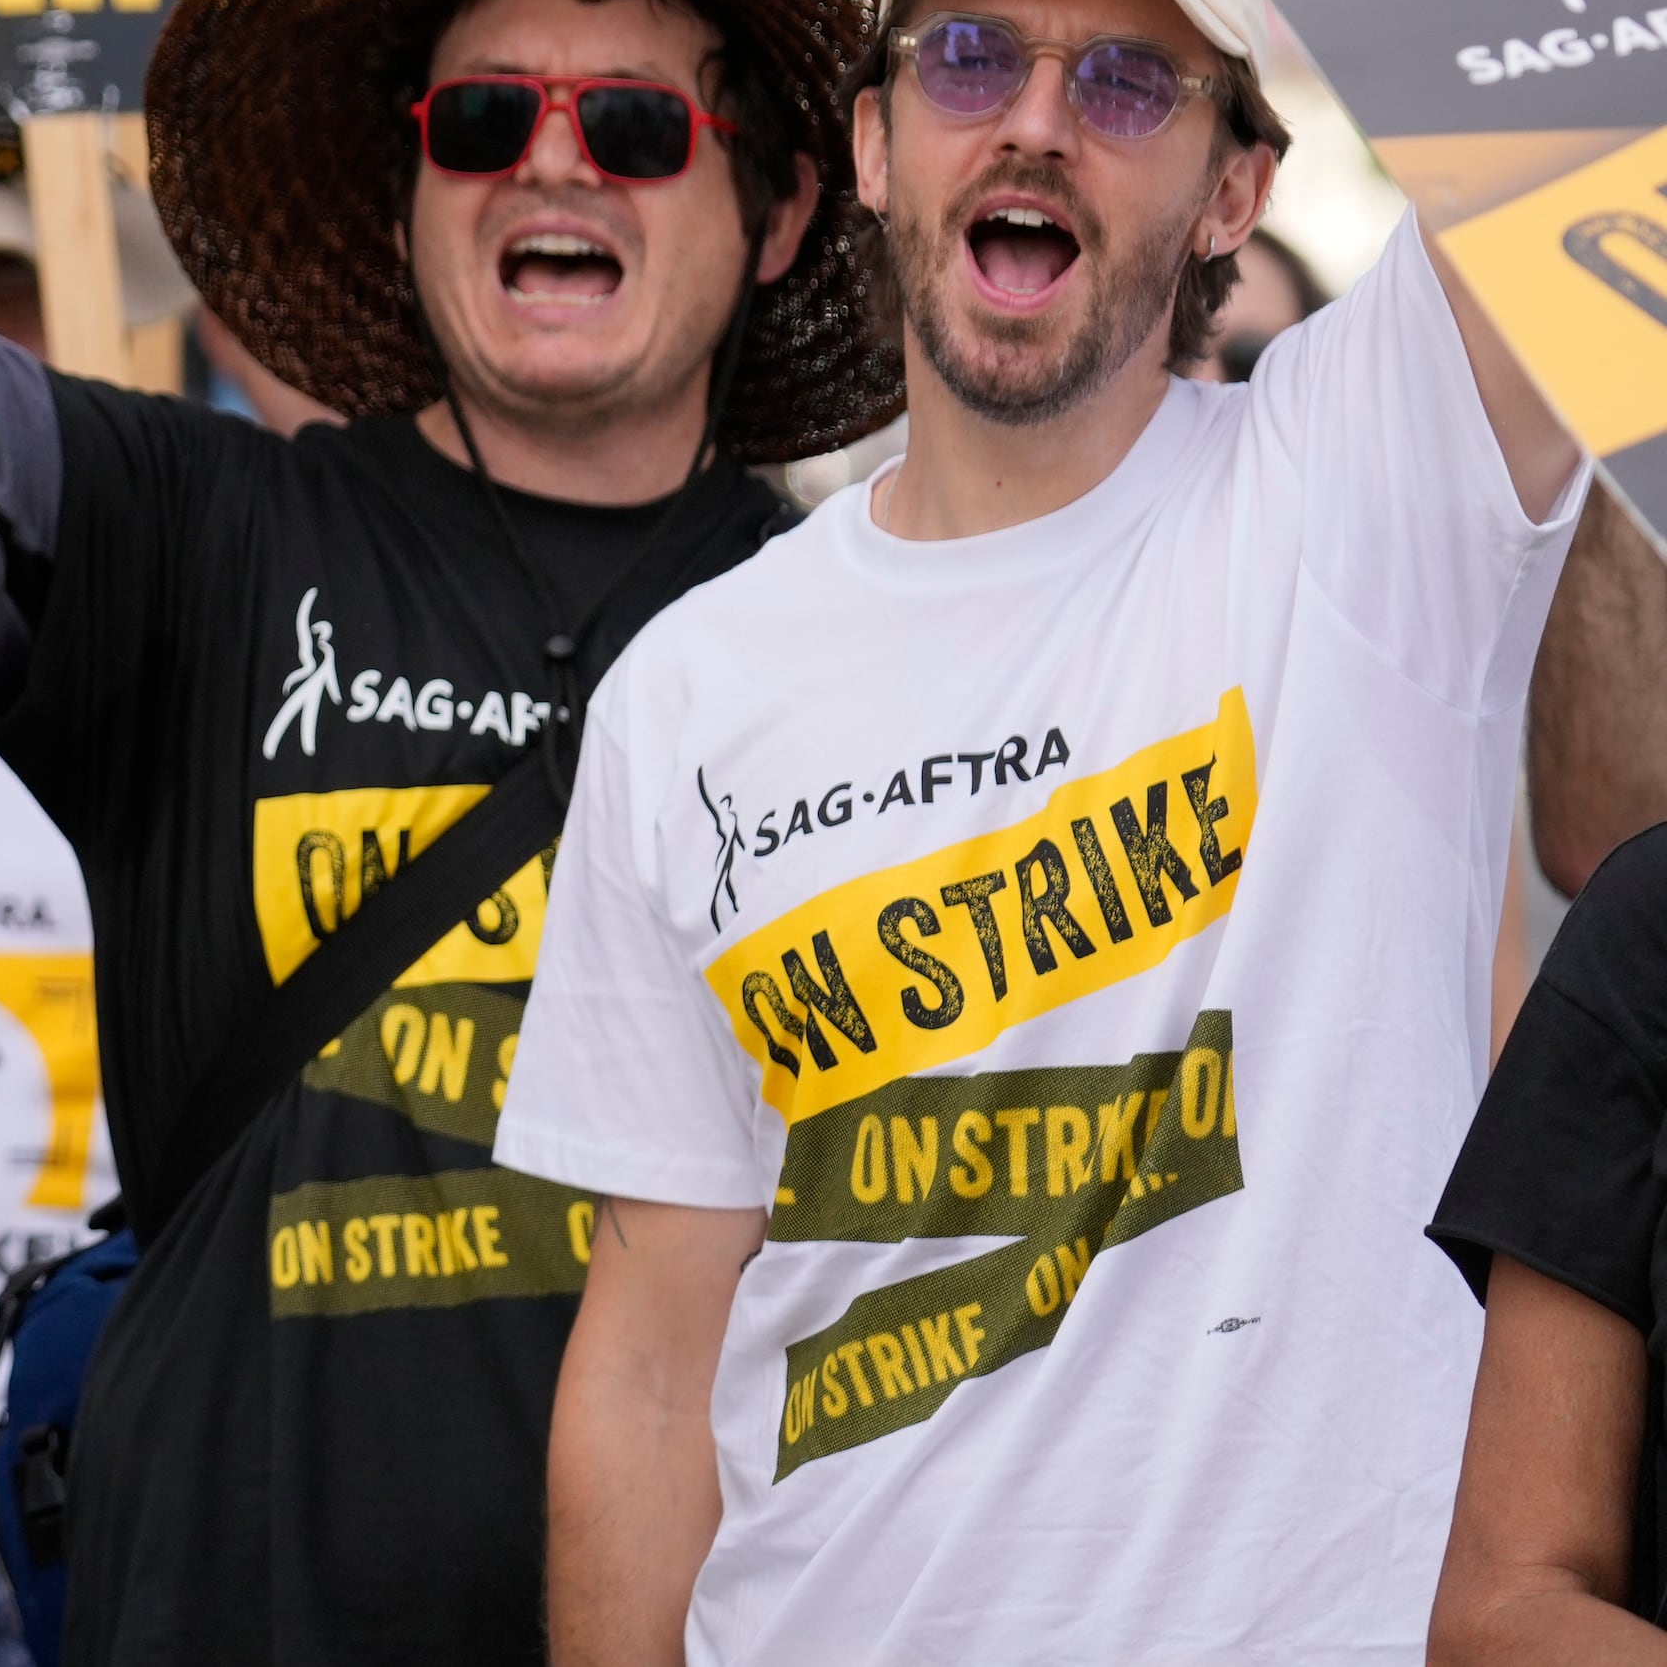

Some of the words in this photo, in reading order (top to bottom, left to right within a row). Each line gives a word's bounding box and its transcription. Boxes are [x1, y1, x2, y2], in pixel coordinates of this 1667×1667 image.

[742, 929, 878, 1078] ON
[877, 754, 1244, 1030] STRIKE
[381, 1003, 475, 1103] ON
[850, 1113, 939, 1203] ON
[270, 1219, 335, 1290] ON
[343, 1205, 508, 1281] STRIKE
[785, 1366, 819, 1446] ON
[821, 1301, 983, 1417] STRIKE
